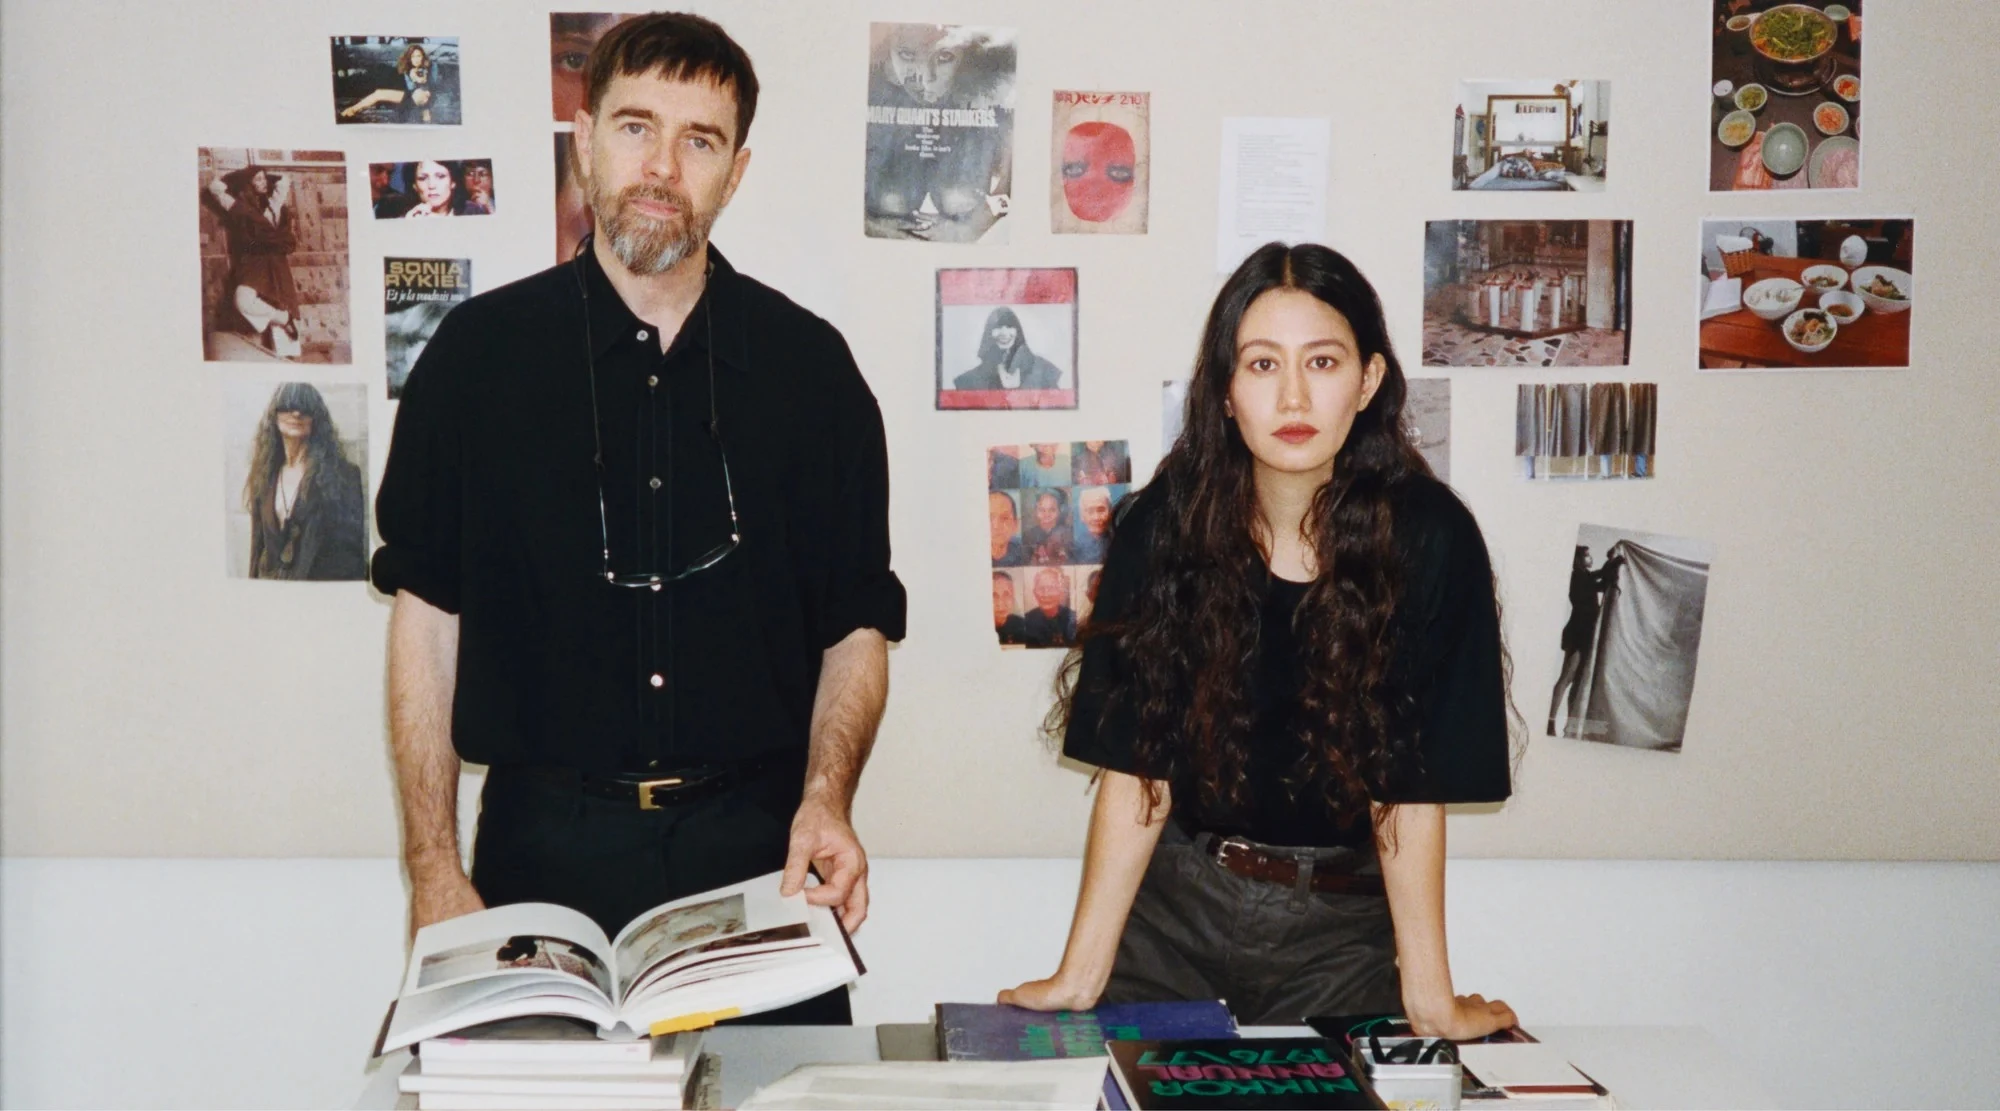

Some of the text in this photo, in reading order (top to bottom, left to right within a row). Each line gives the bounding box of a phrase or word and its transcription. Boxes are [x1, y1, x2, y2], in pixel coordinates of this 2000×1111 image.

[390, 261, 464, 275] SONIA
[385, 273, 469, 288] RYKIEL
[1137, 1063, 1346, 1080] ANNUAL
[1149, 1078, 1359, 1096] NIKKOR
